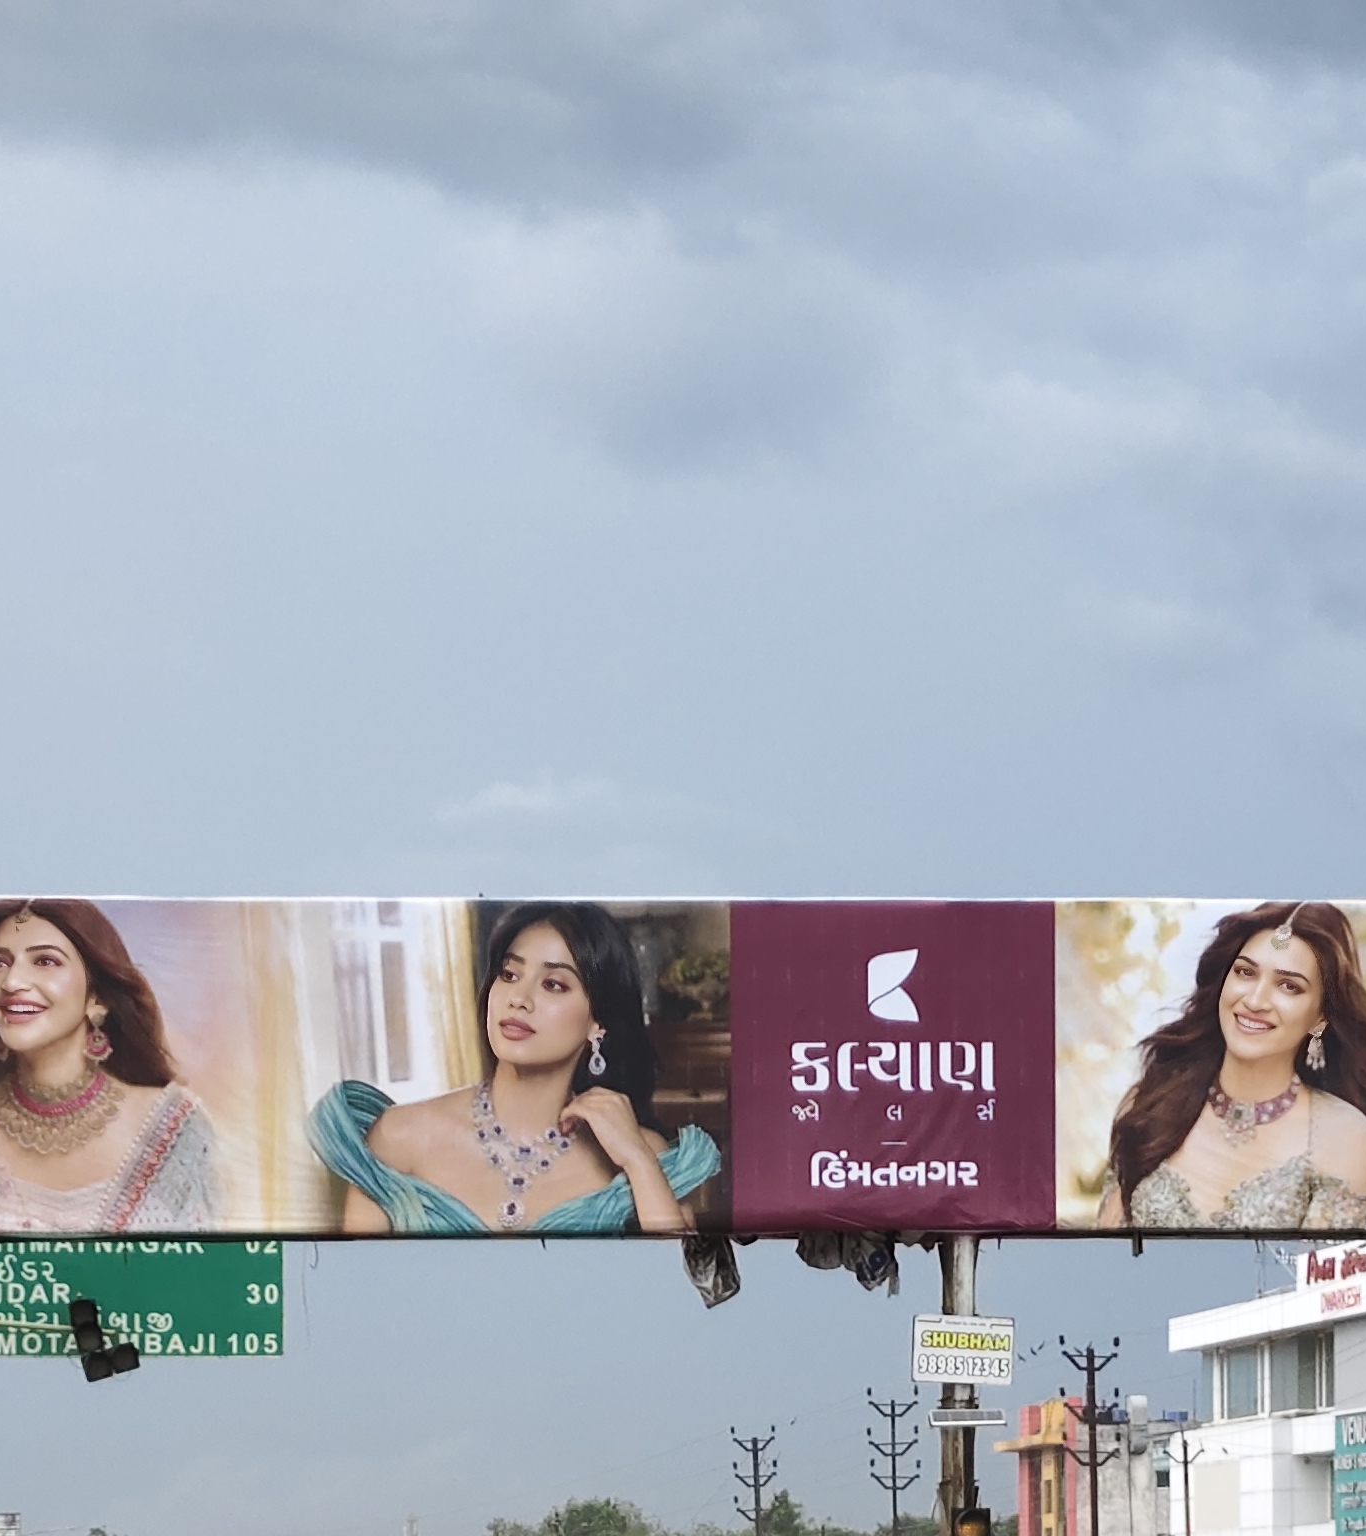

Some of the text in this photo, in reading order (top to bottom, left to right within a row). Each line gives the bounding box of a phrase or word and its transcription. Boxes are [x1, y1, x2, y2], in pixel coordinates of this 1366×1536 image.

[790, 1041, 996, 1092] કલ્યાણ
[810, 1150, 979, 1188] હિંમતનગર
[246, 1284, 278, 1304] 30
[227, 1333, 278, 1354] 105
[921, 1330, 1011, 1351] SHUBHAM
